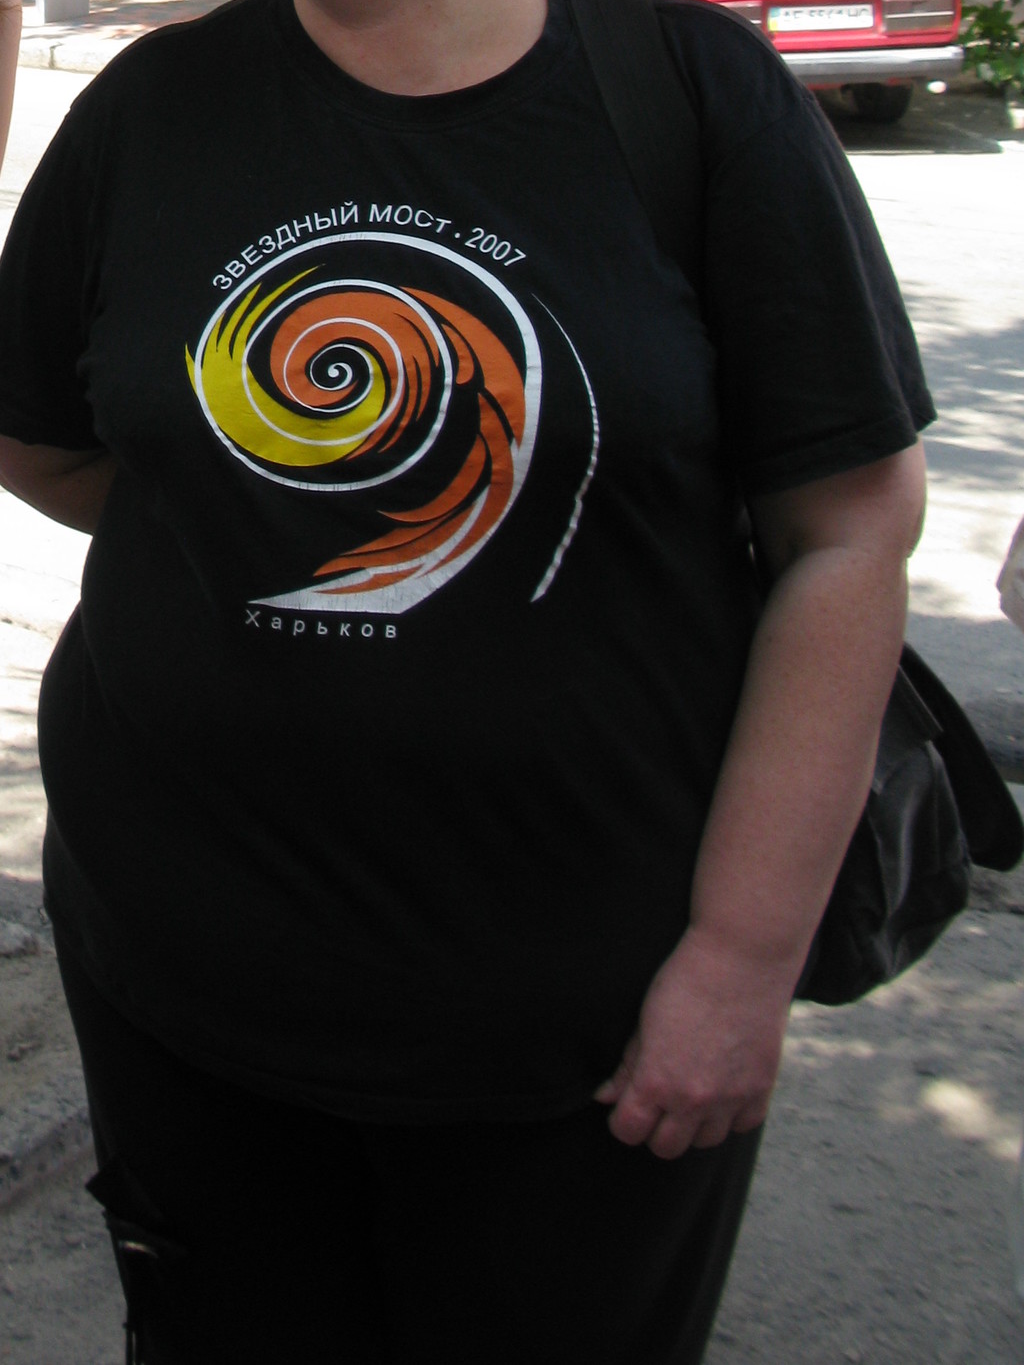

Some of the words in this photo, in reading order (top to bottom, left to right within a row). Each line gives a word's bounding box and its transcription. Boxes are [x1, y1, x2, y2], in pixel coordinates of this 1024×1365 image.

[212, 201, 359, 291] ЗВЕЗДНЫЙ
[369, 203, 452, 234] МОСТ
[463, 227, 527, 267] 2007
[245, 609, 397, 639] Харьков
